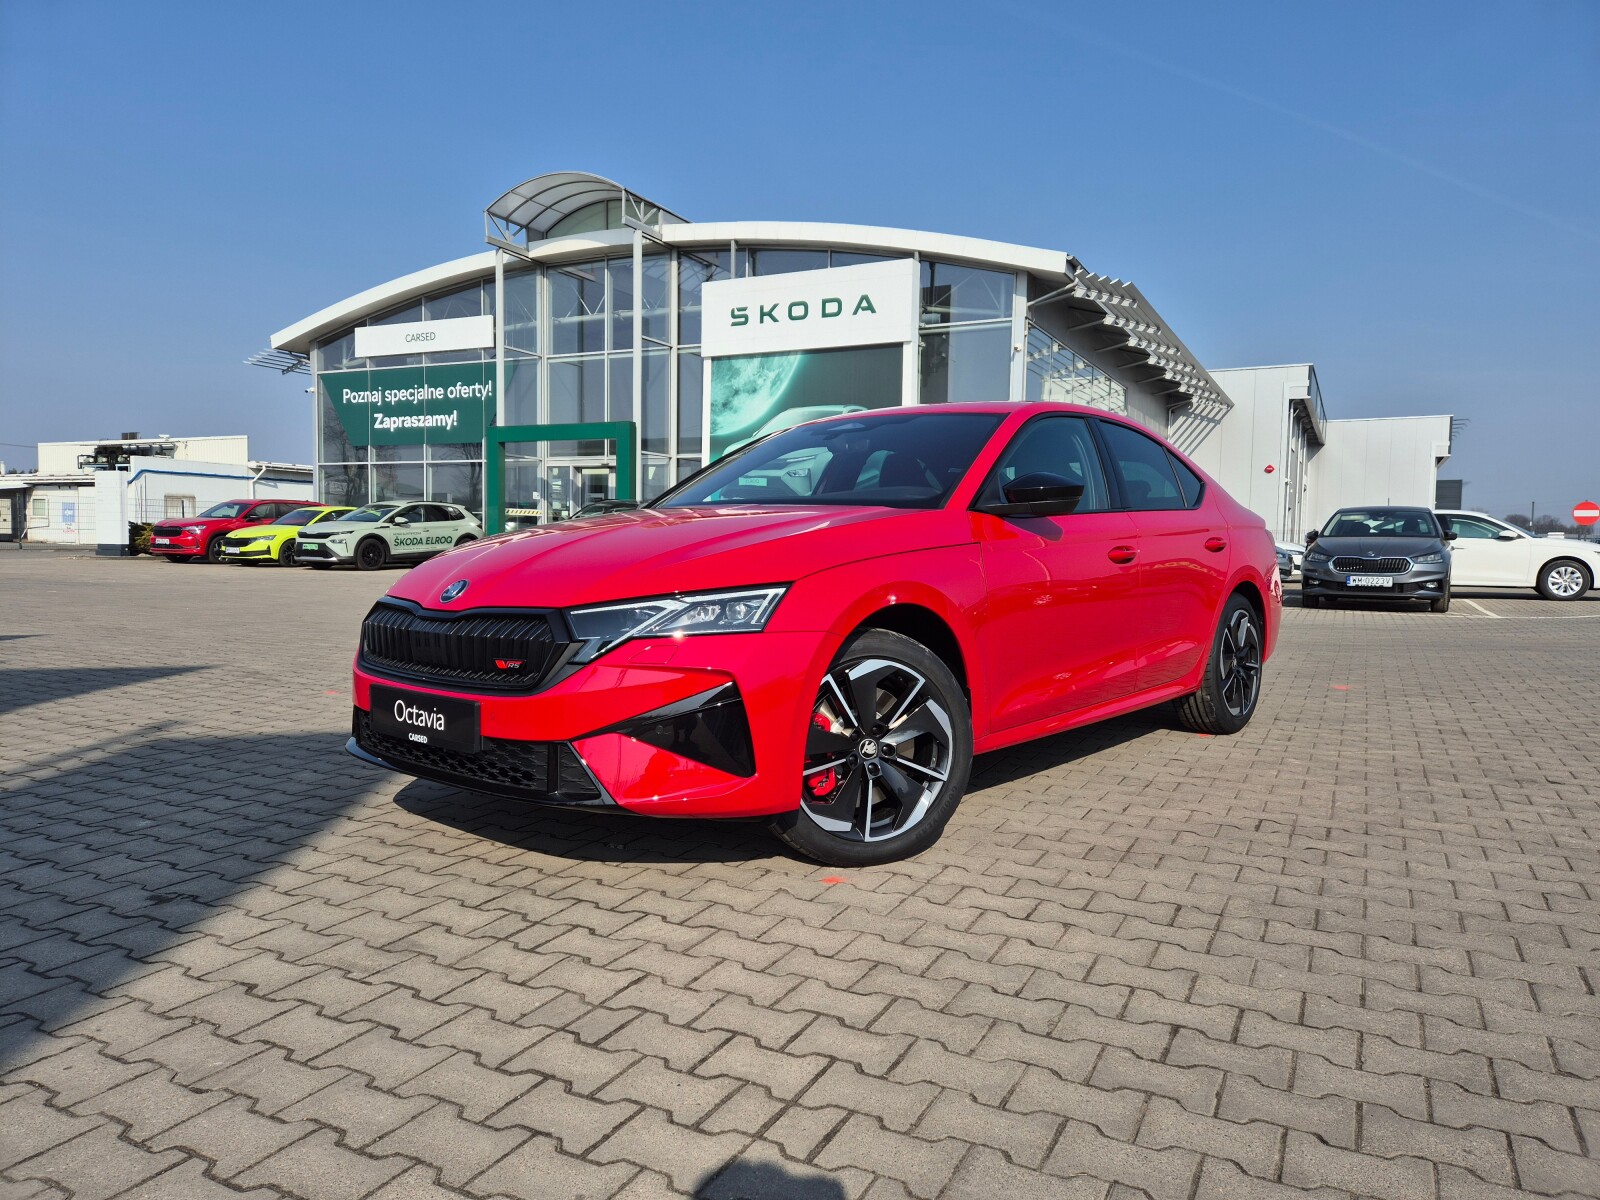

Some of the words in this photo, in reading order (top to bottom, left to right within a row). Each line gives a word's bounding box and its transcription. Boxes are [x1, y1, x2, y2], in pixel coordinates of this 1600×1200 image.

[405, 331, 436, 343] CARSED
[342, 386, 382, 406] Poznaj
[384, 383, 444, 405] specjalne
[447, 380, 493, 401] oferty!
[373, 409, 458, 432] Zapraszamy!
[426, 535, 452, 545] ELROQ
[394, 699, 445, 731] Octavia
[408, 732, 428, 744] CARSED
